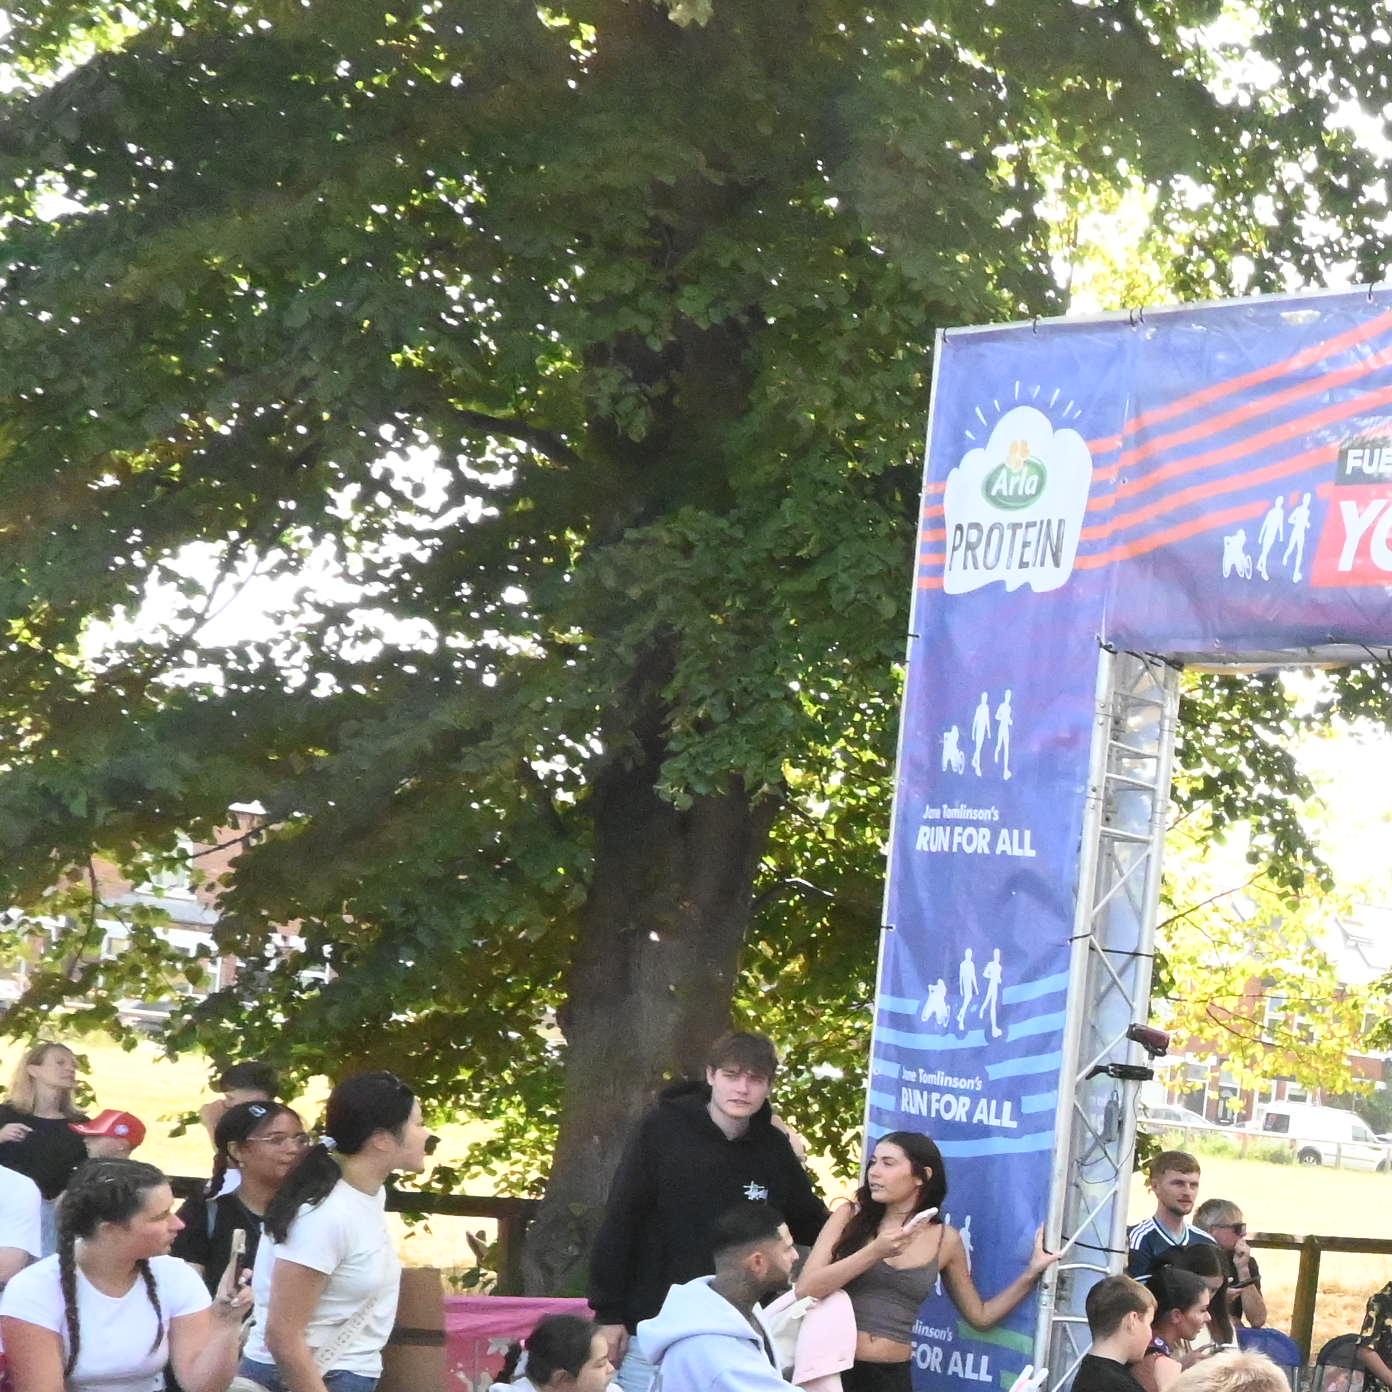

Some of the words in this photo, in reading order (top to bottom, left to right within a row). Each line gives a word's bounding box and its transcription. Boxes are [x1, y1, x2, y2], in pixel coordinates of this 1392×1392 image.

[991, 470, 1037, 498] Arla
[948, 518, 1066, 573] PROTEIN
[916, 825, 950, 852] RUN
[952, 827, 990, 855] FOR
[996, 828, 1037, 857] ALL
[918, 1068, 982, 1091] Tomlinson's
[930, 1092, 971, 1123] FOR
[972, 1098, 1018, 1128] ALL
[947, 1351, 993, 1382] ALL
